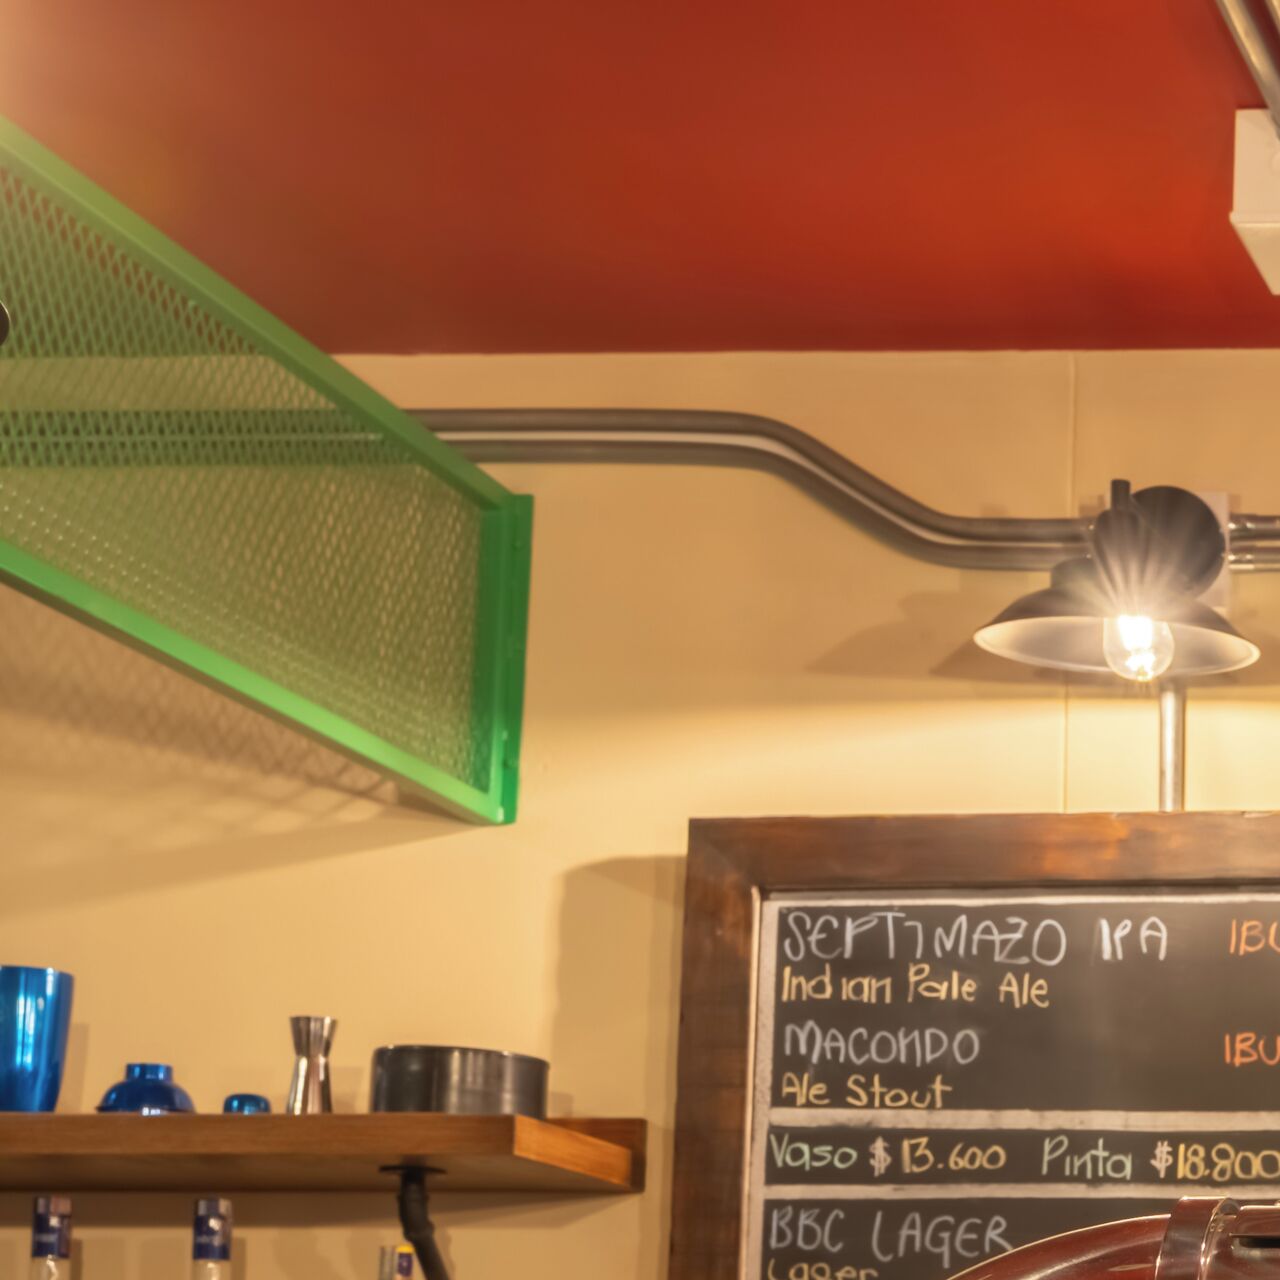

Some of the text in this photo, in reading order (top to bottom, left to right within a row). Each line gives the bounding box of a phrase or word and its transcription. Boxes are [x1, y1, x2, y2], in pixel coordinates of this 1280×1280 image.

[1099, 914, 1169, 962] IPA
[782, 963, 1050, 1009] Indian Pale Ale
[783, 1020, 981, 1067] MACONDO
[846, 1073, 953, 1109] Stout
[770, 1132, 858, 1170] Vaso
[1041, 1135, 1132, 1182] Pinta
[769, 1205, 1014, 1269] BBC LAGER
